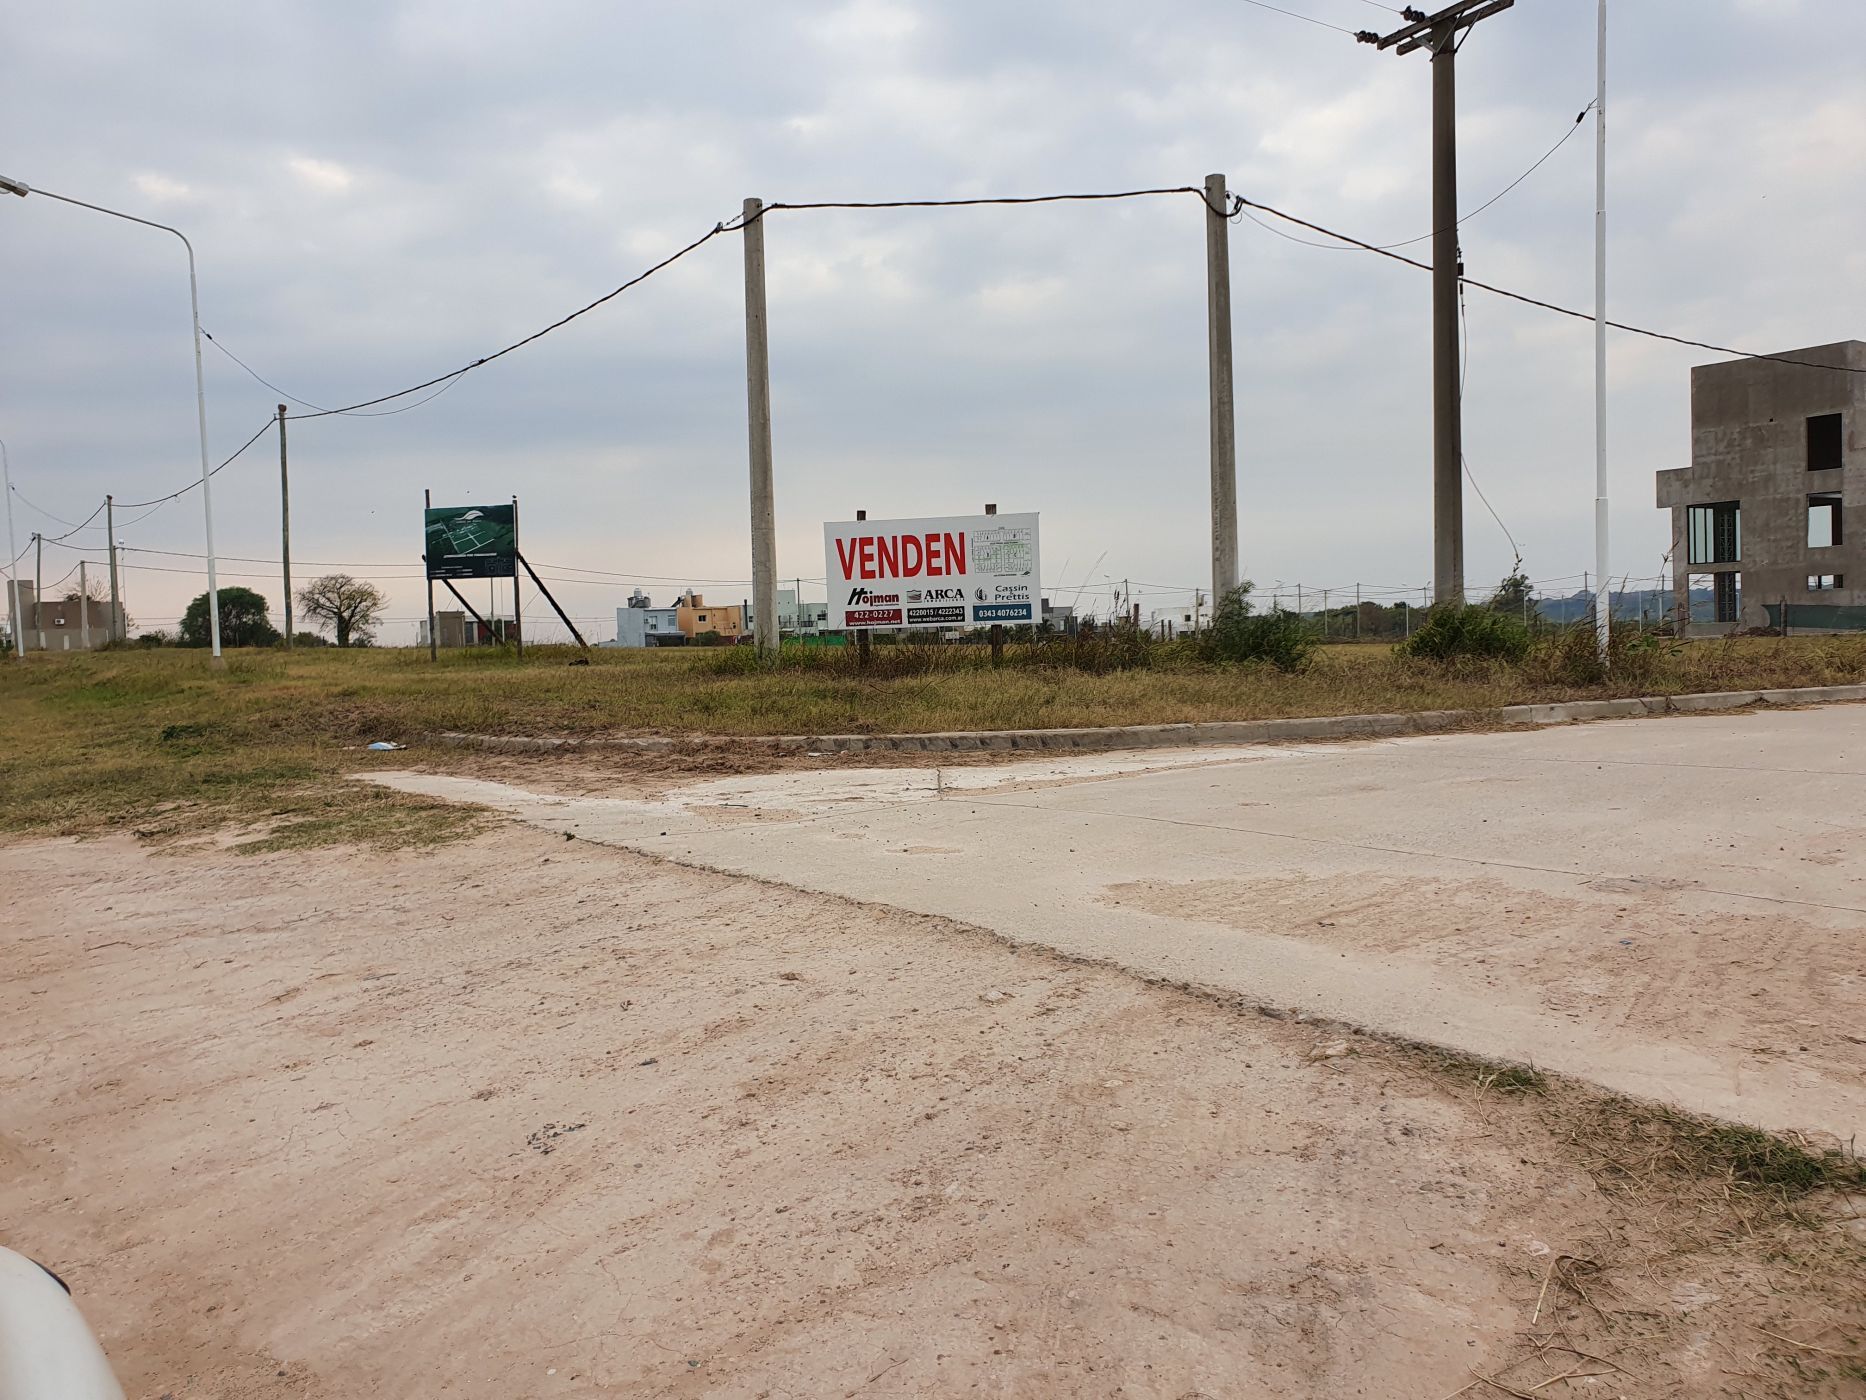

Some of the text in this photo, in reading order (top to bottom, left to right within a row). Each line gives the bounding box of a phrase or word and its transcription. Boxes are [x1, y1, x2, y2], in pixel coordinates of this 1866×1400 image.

[835, 532, 966, 580] VENDEN
[847, 588, 900, 606] Hojman
[924, 588, 965, 599] ARCA
[854, 610, 893, 619] 422-0227
[978, 608, 1027, 617] 0343 4076234
